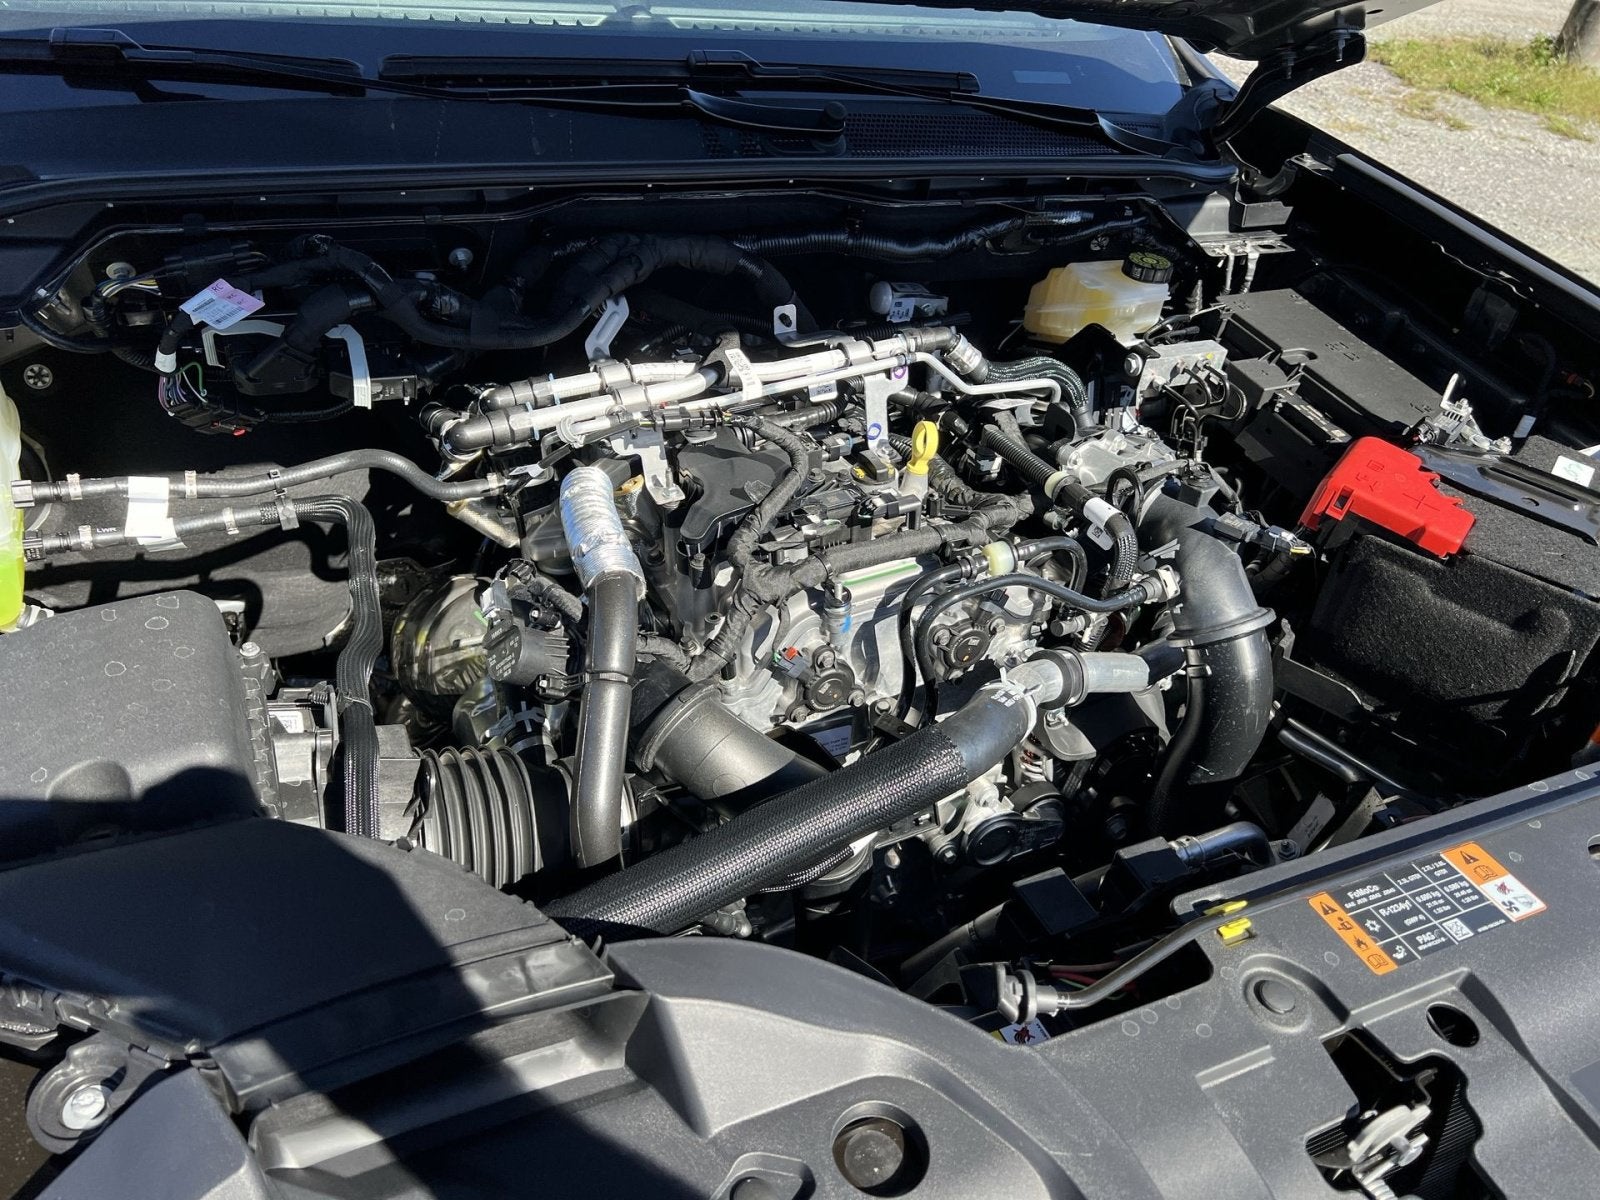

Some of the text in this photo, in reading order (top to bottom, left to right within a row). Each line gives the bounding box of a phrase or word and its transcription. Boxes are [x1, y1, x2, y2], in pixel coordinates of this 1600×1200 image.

[211, 282, 224, 293] RC
[1347, 885, 1379, 899] FoMoCo
[1378, 900, 1412, 916] R-1234yf
[1416, 932, 1435, 944] PAG
